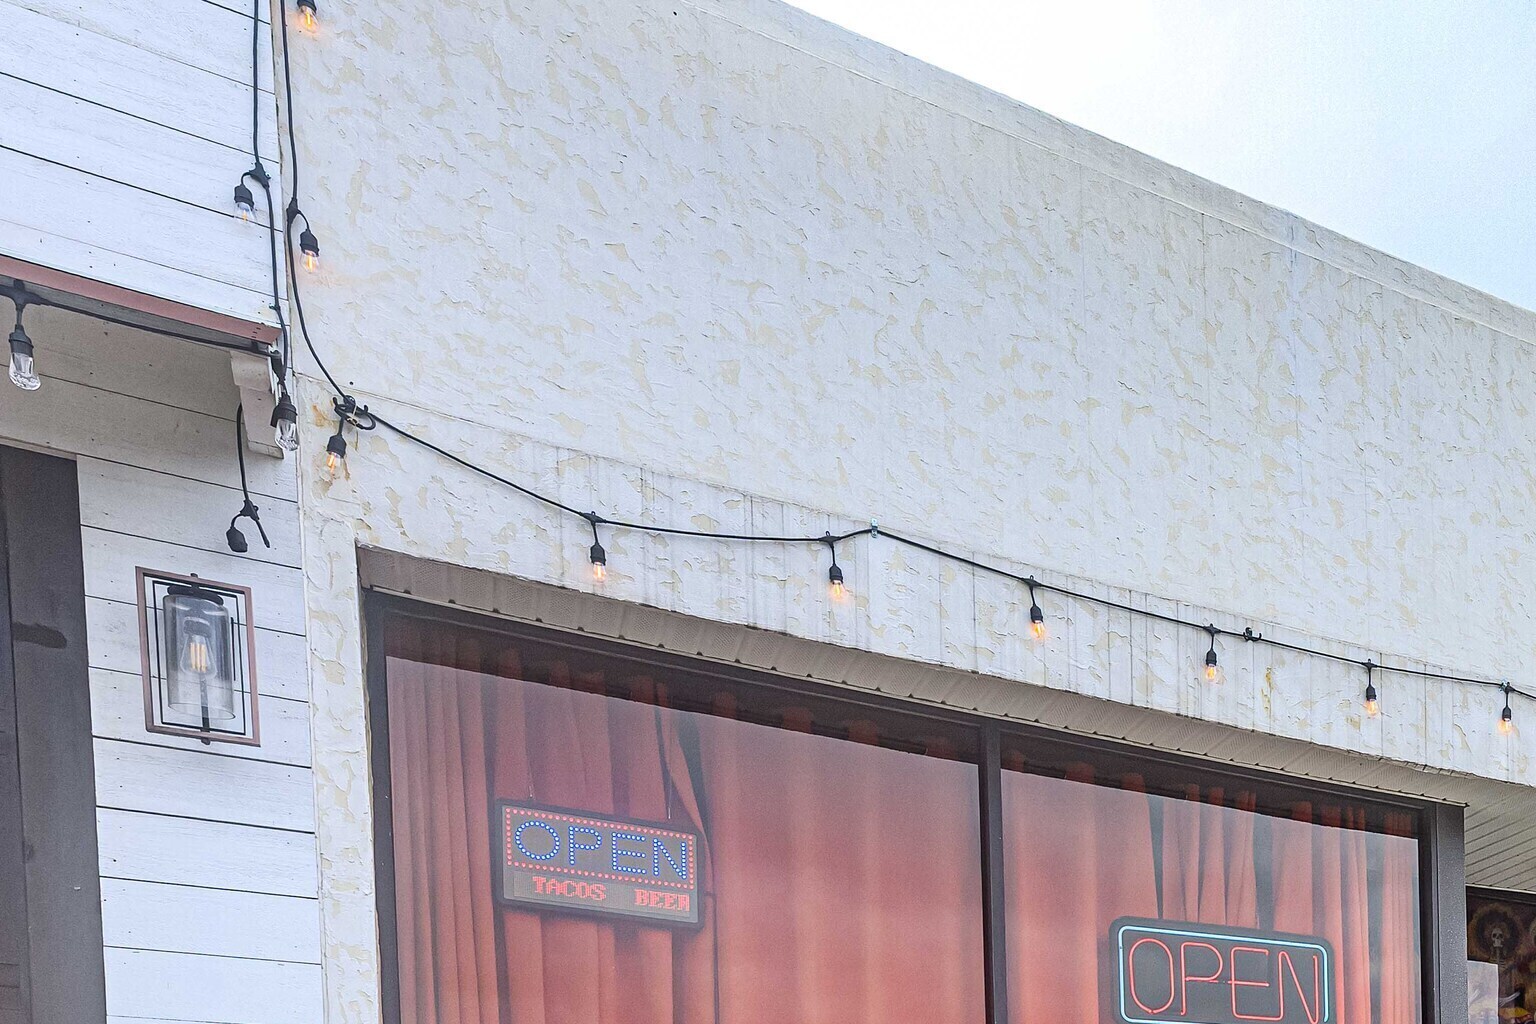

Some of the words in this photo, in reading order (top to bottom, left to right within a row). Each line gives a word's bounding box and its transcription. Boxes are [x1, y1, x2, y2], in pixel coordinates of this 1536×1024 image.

[515, 820, 688, 880] OPEN
[532, 876, 606, 901] TACOS
[1128, 938, 1319, 1024] OPEN
